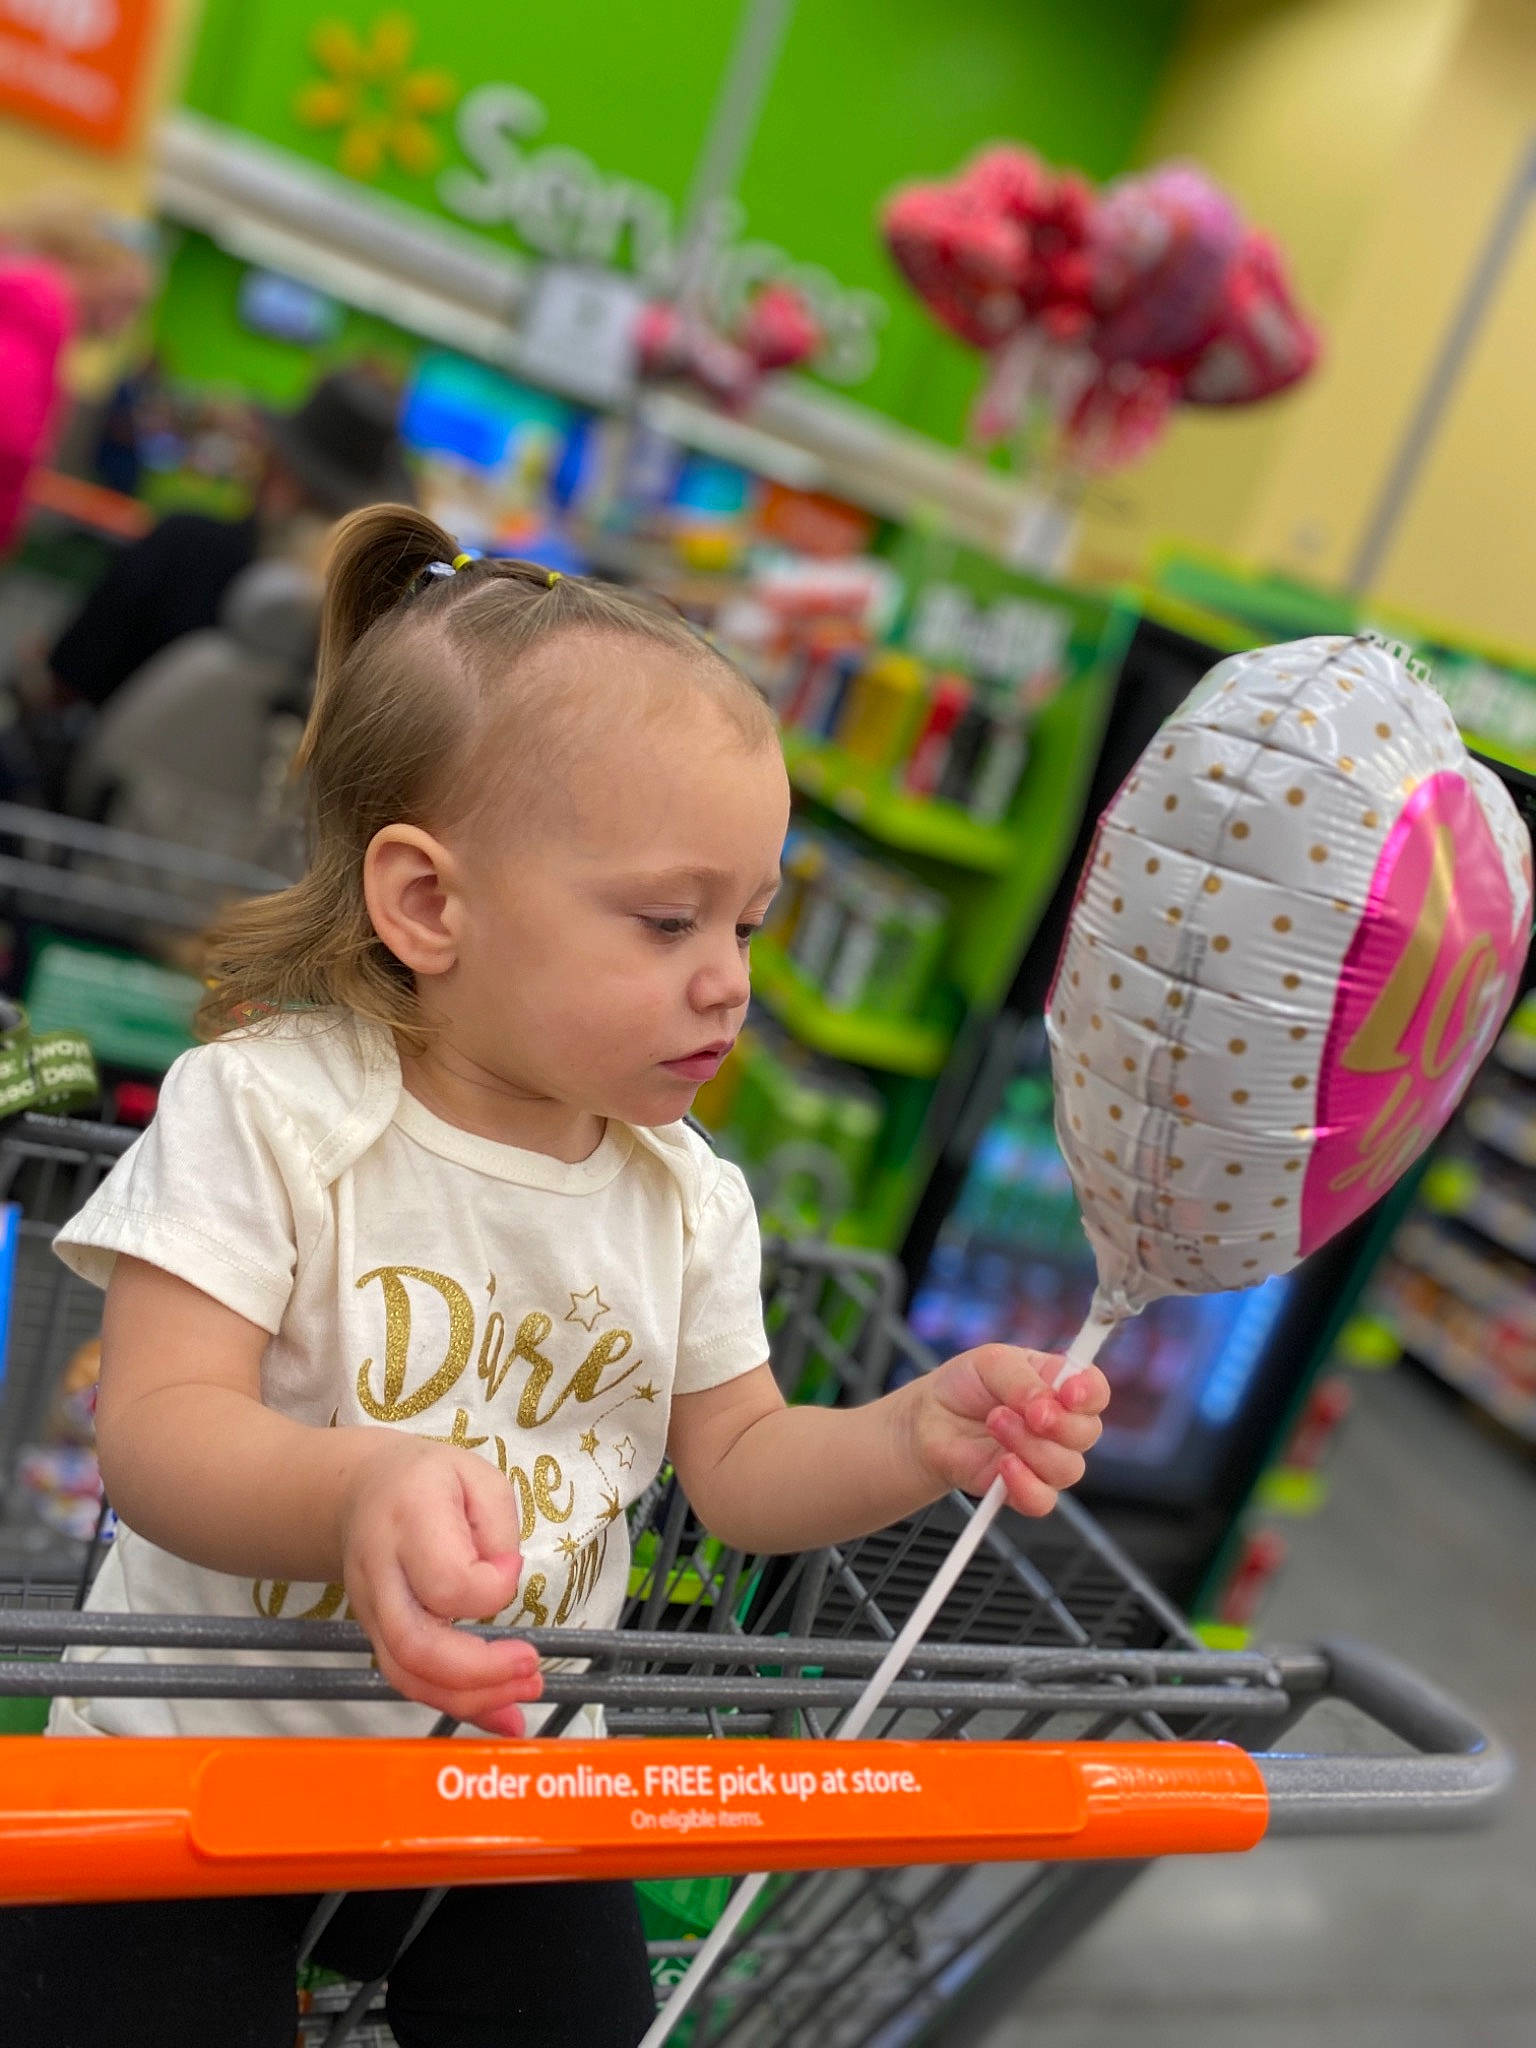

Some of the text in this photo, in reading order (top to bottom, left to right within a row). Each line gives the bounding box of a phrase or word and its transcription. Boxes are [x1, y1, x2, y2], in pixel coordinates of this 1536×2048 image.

[437, 1763, 922, 1803] Order online. FREE pick up at store.
[631, 1808, 764, 1834] On eligible items.
